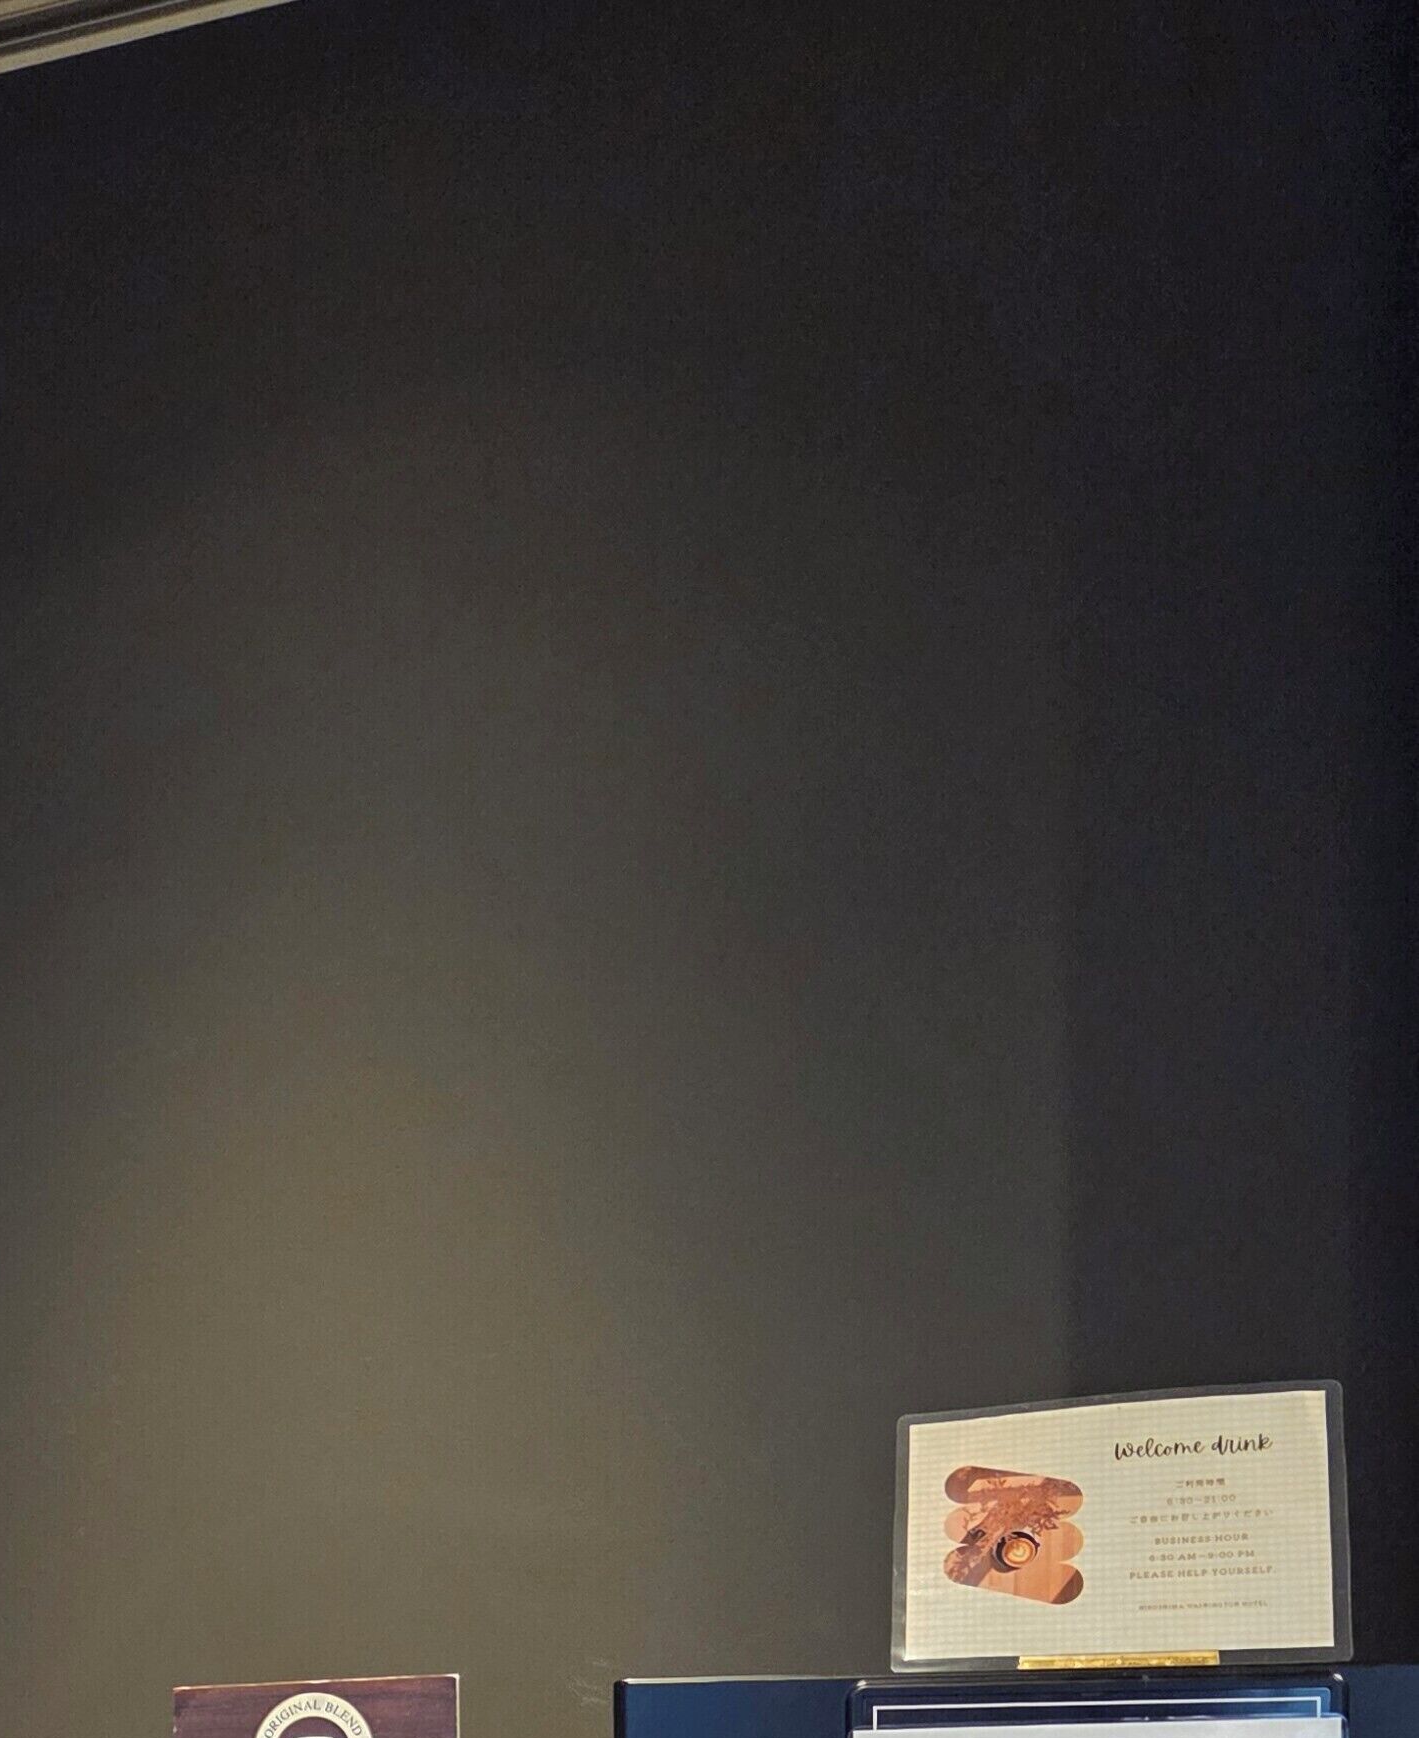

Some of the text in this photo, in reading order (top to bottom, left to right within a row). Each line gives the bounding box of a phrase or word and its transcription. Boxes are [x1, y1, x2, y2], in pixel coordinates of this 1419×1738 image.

[1114, 1433, 1274, 1460] Welcome drink
[1154, 1532, 1249, 1546] BUSINESS HOUR
[1129, 1570, 1174, 1580] PLEASE
[1177, 1568, 1208, 1578] HELP
[264, 1699, 321, 1738] ORIGINAL
[324, 1701, 363, 1736] BLEND
